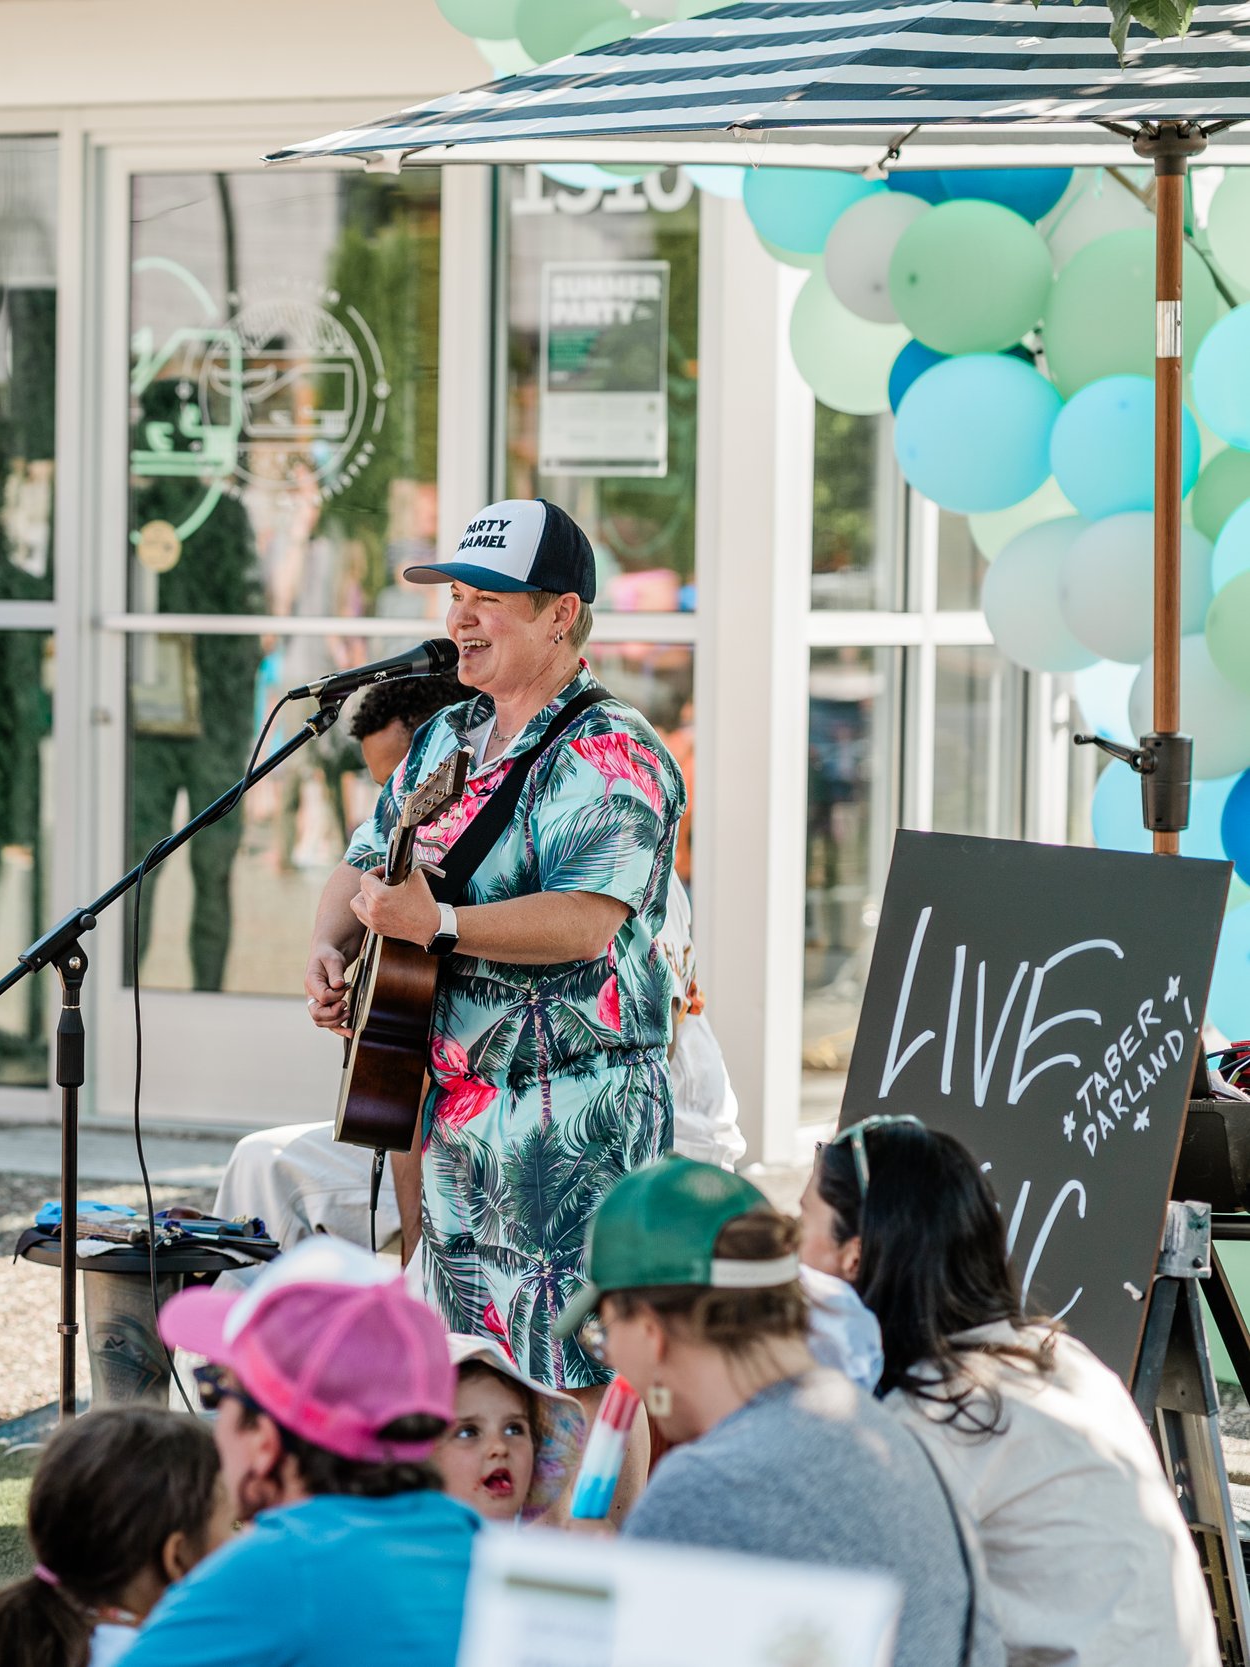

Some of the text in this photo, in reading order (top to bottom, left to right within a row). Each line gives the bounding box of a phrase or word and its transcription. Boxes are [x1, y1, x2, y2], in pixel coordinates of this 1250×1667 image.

[551, 274, 661, 300] SUMMER
[551, 301, 635, 325] PARTY
[465, 519, 512, 535] PARTY
[878, 905, 1125, 1108] LIVE
[1076, 998, 1162, 1116] TABER
